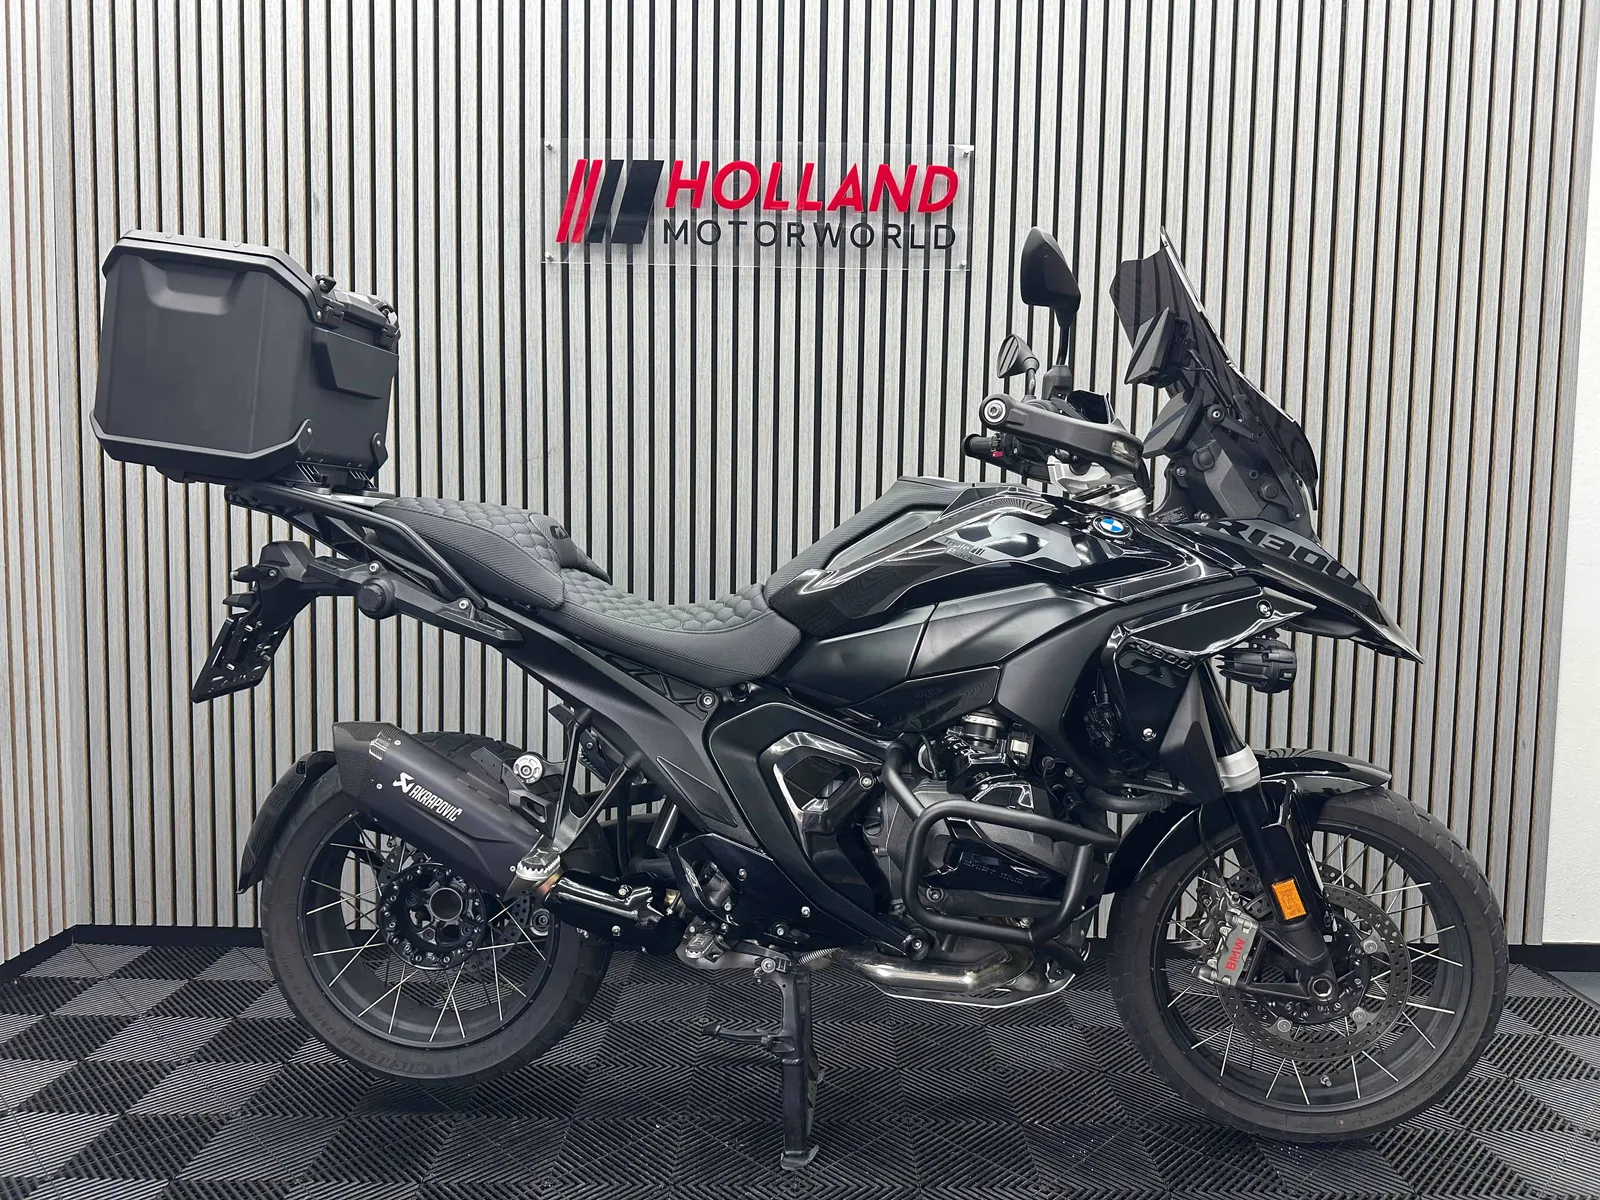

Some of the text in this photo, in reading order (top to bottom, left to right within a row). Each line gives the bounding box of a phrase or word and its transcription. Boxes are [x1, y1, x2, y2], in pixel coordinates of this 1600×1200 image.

[664, 159, 959, 213] HOLLAND
[663, 219, 956, 250] MOTORWORLD
[1224, 936, 1246, 971] BMW
